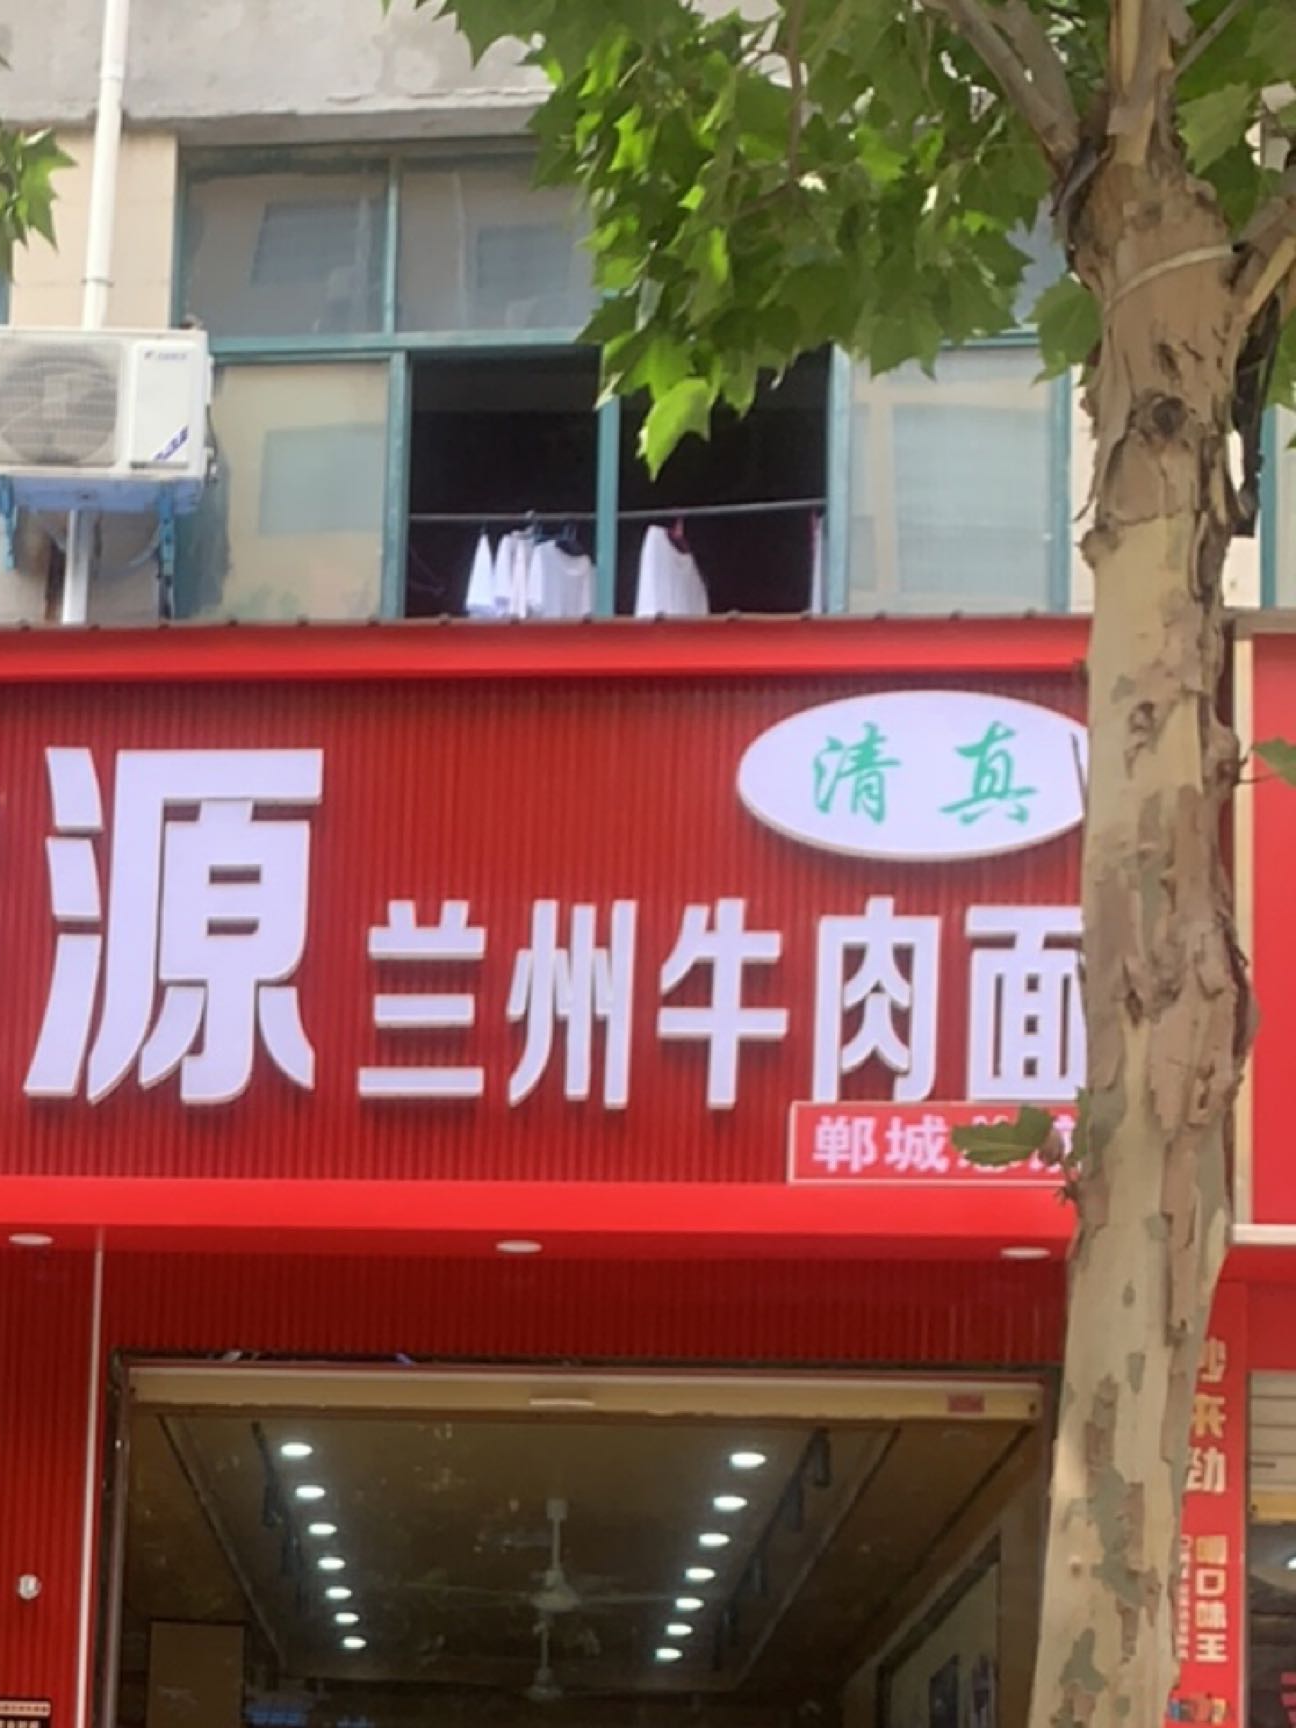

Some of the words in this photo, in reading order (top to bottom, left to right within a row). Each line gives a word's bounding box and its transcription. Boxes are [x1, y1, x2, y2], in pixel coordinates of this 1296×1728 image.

[812, 721, 1039, 826] 清真
[357, 896, 1086, 1110] 兰州牛肉面
